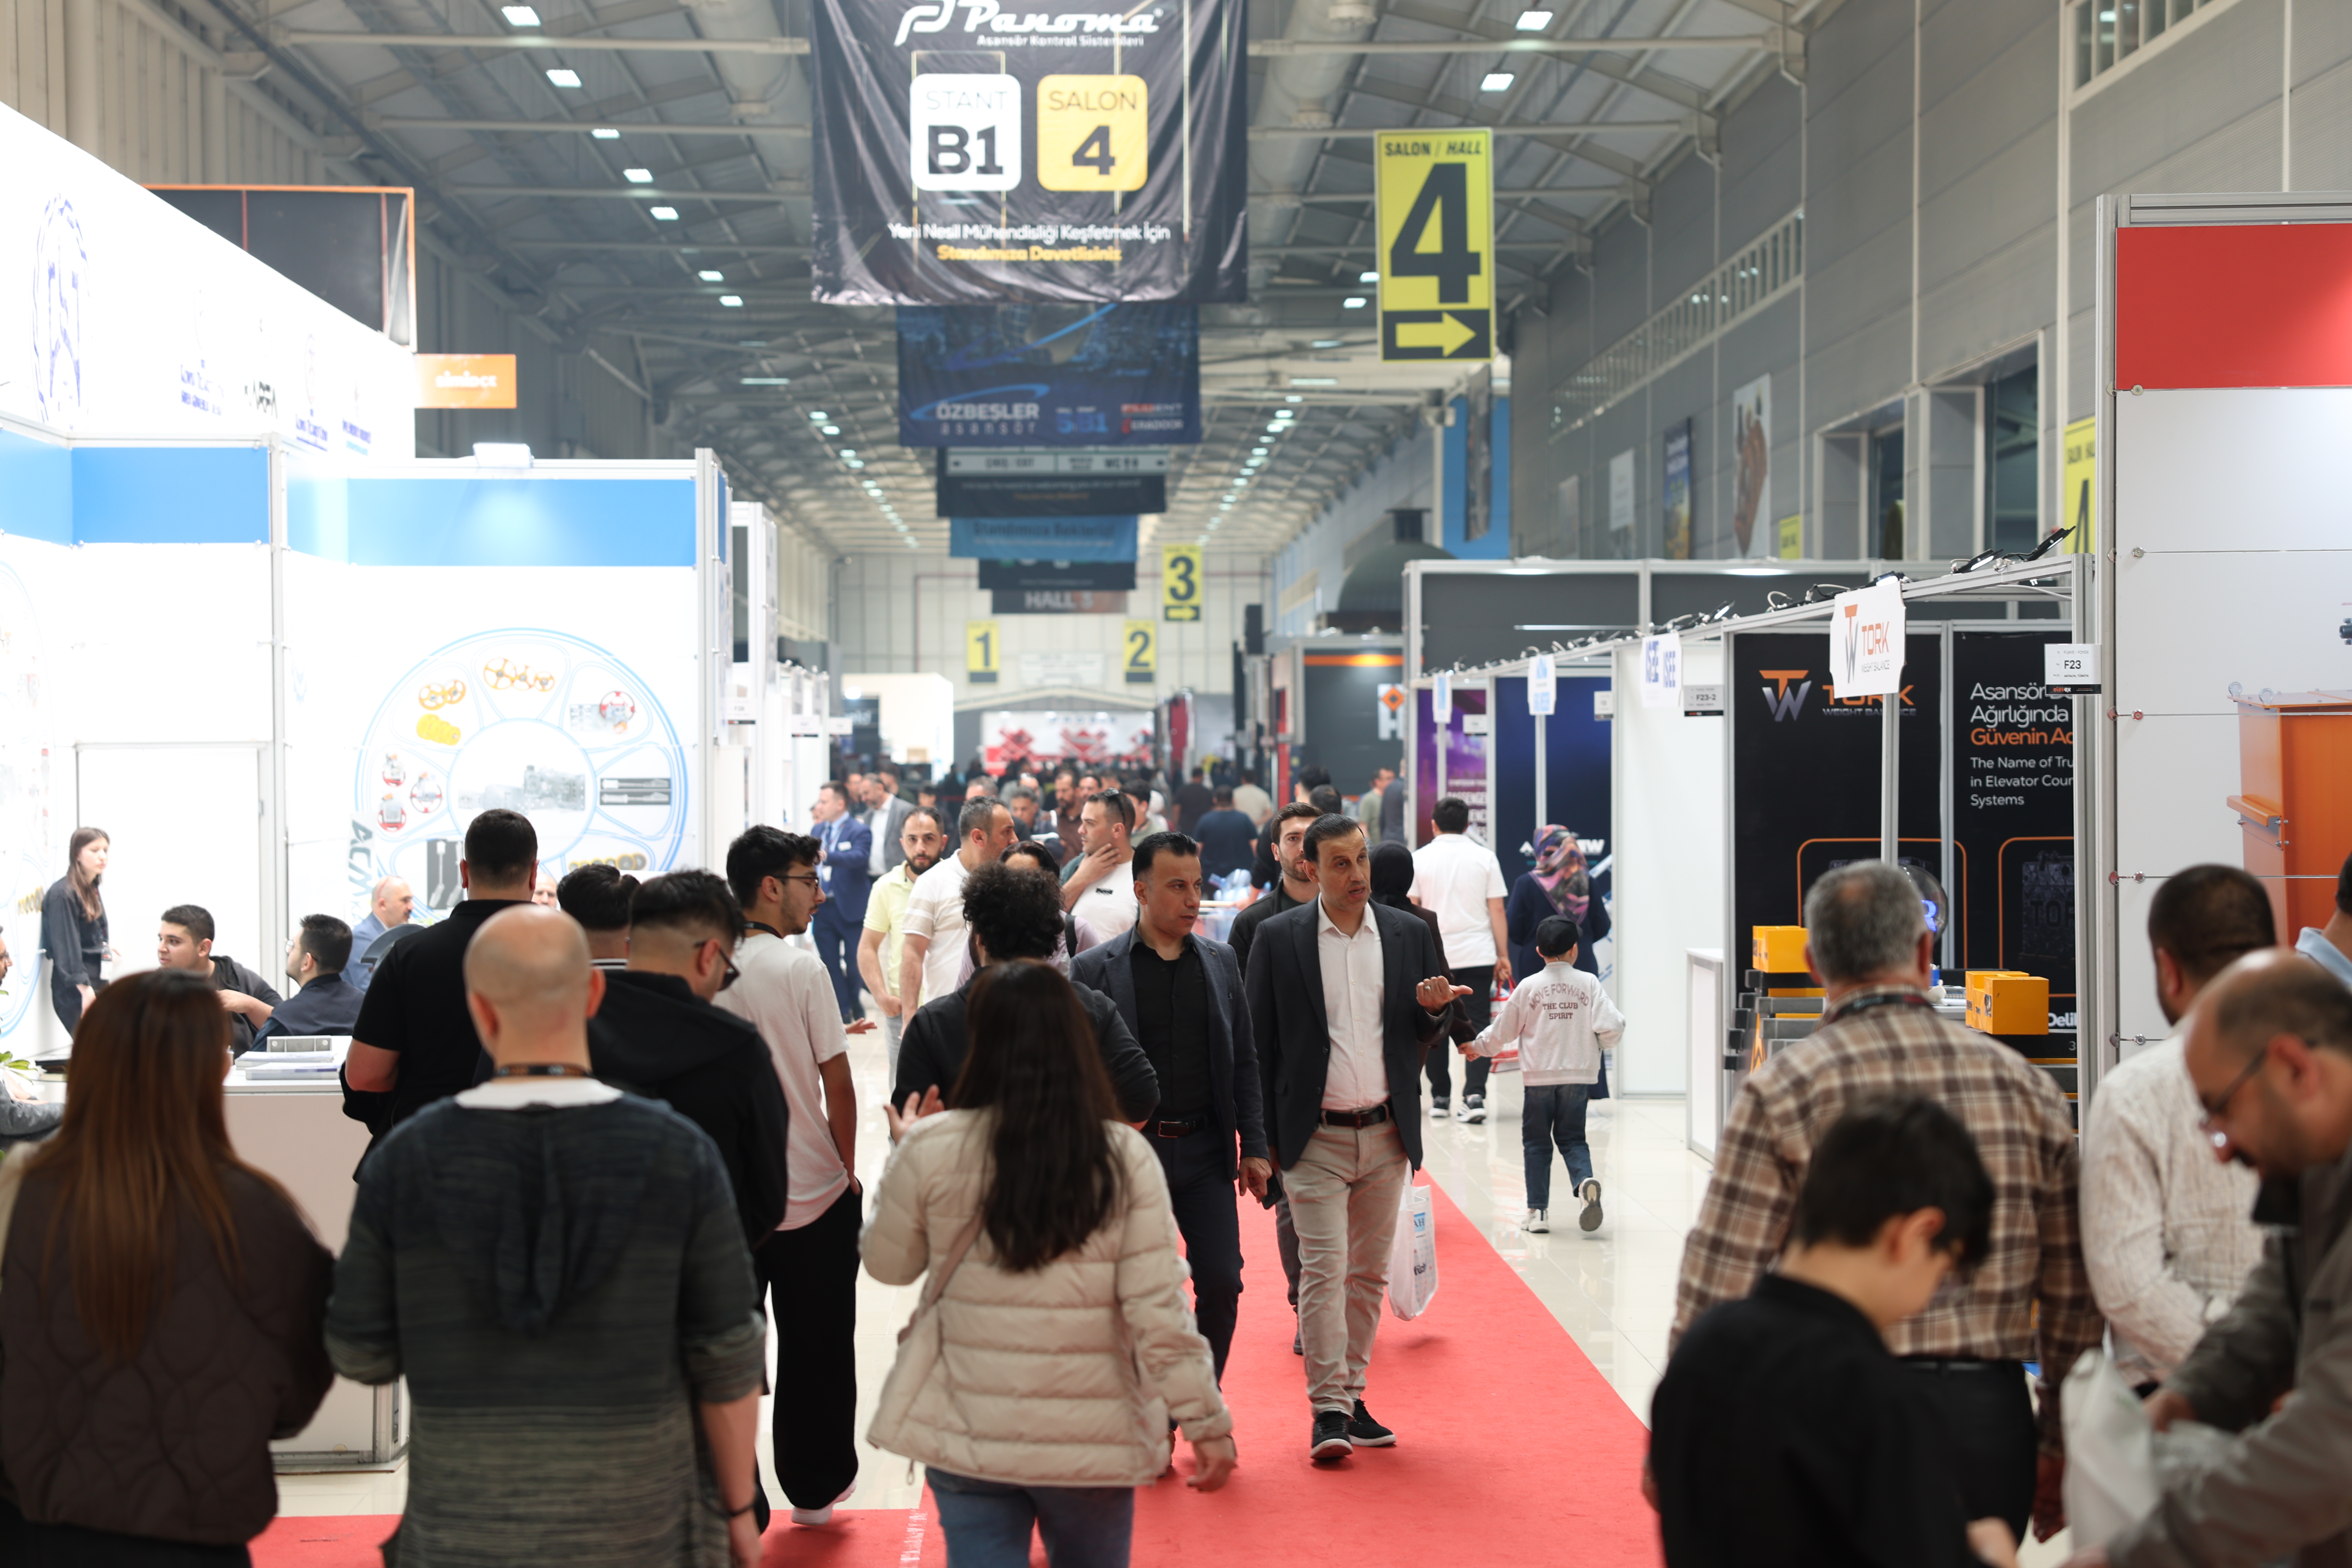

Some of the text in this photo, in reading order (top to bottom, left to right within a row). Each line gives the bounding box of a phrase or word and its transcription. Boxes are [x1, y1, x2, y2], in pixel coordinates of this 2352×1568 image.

[926, 91, 1007, 110] STANT
[1049, 91, 1137, 111] SALON
[928, 125, 1004, 175] B1
[1072, 124, 1115, 175] 4
[1385, 142, 1431, 157] SALON
[1446, 140, 1482, 156] HALL
[1390, 162, 1481, 304] 4
[1170, 556, 1195, 601] 3
[1024, 590, 1077, 609] HALL
[1862, 621, 1889, 656] TORK
[975, 631, 991, 667] 1
[1129, 631, 1150, 667] 2
[2064, 660, 2081, 669] F23
[1970, 682, 2045, 700] Asansör
[1865, 708, 1916, 716] BACE
[1970, 705, 2069, 728] Ağırlığında
[1971, 727, 2048, 746] Güvenin
[1970, 757, 1994, 769] The
[1998, 757, 2036, 769] Name
[2039, 756, 2053, 768] of
[1971, 776, 1982, 787] in
[1986, 775, 2039, 787] Elevator
[1971, 794, 2025, 809] Systems
[1529, 983, 1589, 1010] MOVE FORWARD
